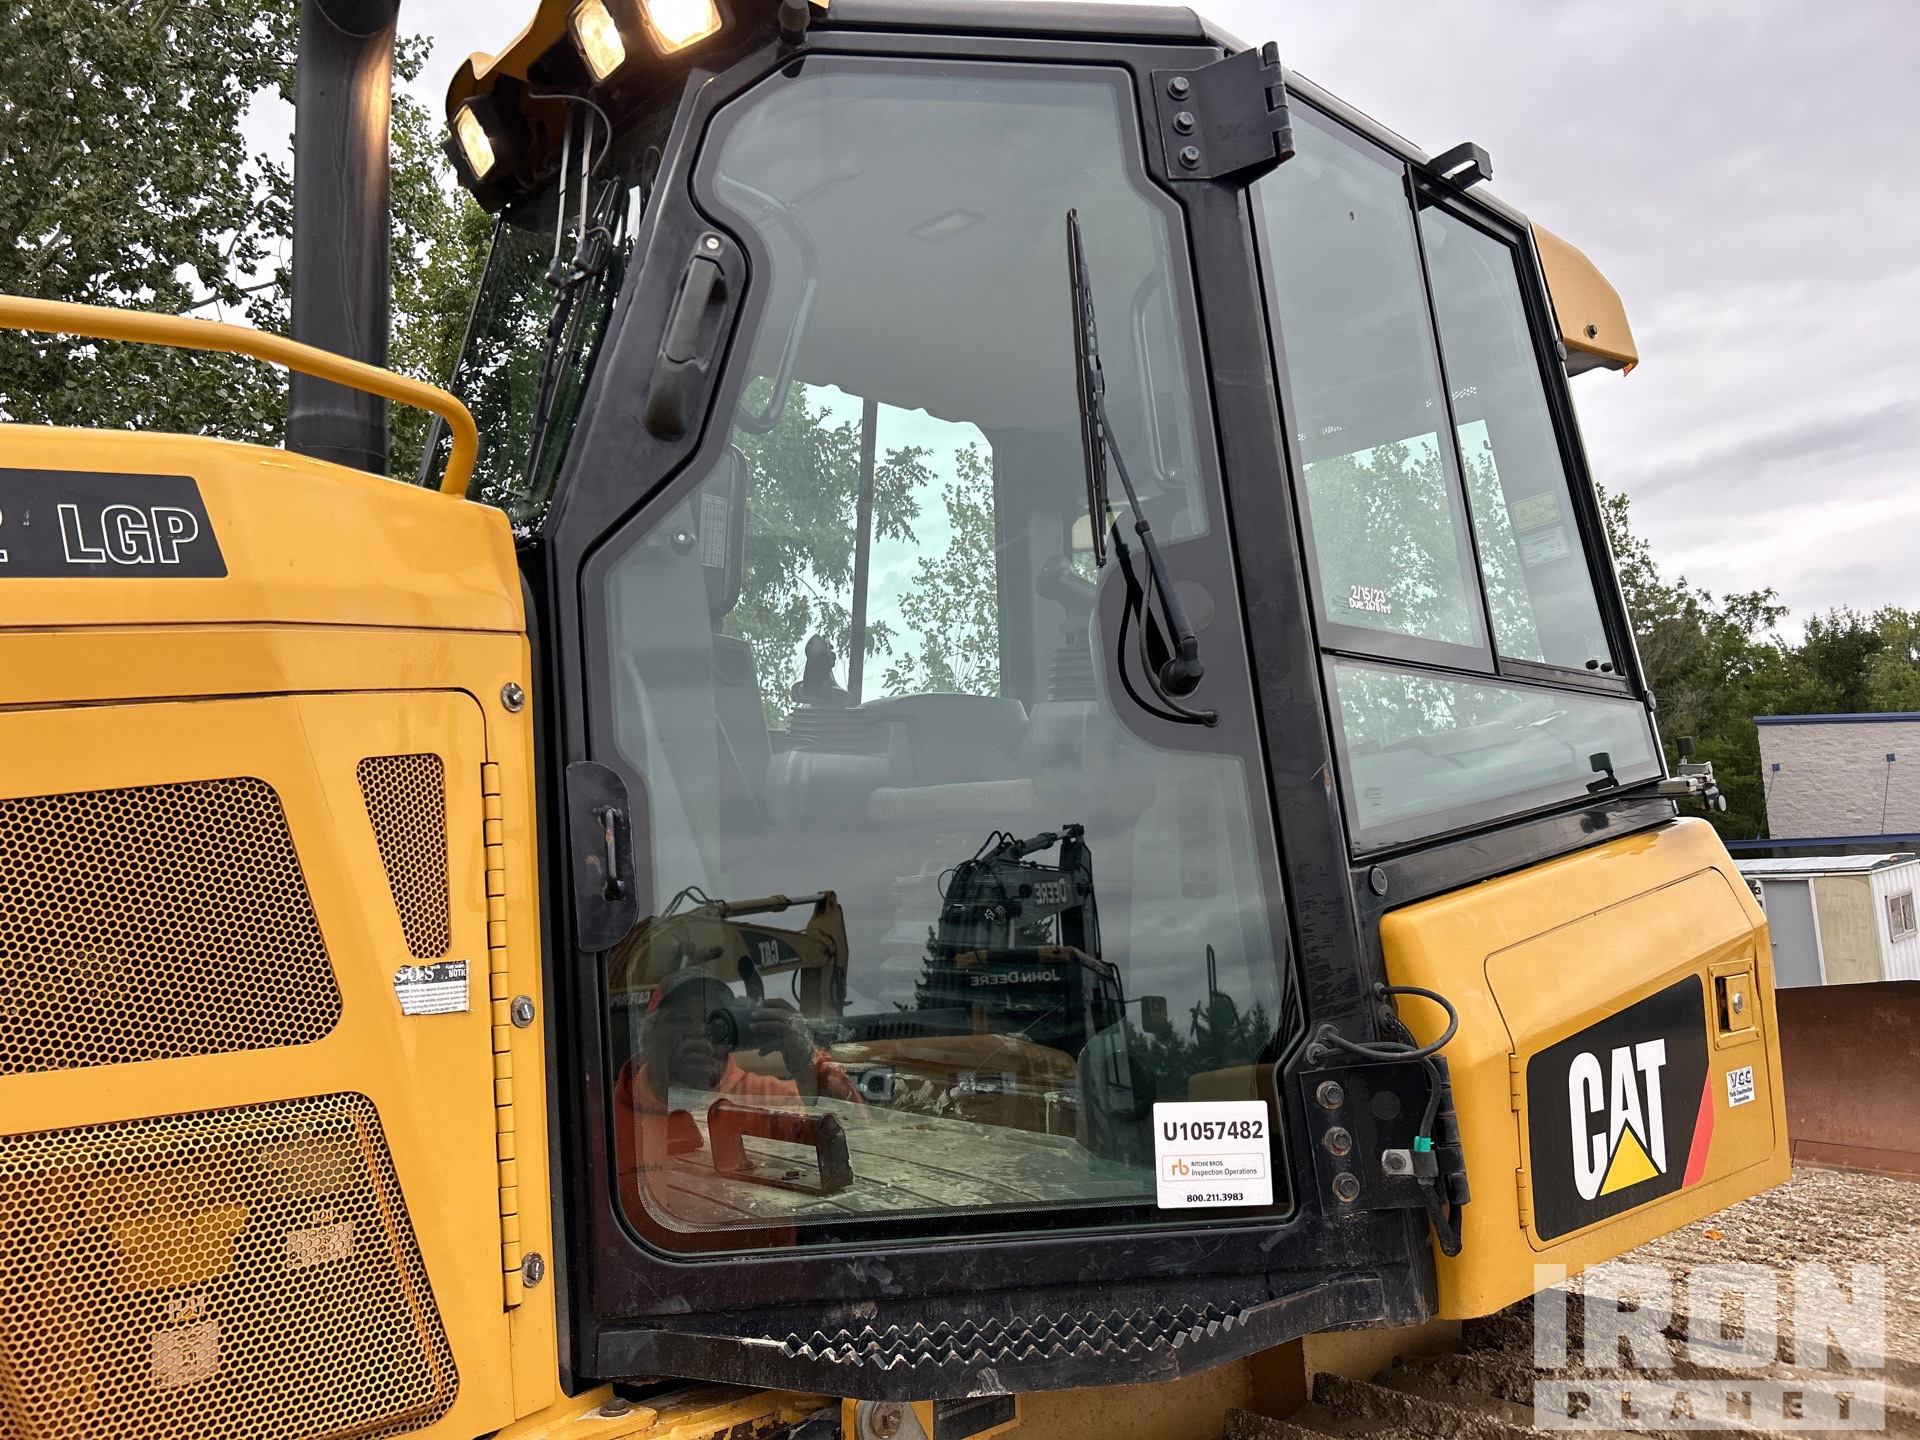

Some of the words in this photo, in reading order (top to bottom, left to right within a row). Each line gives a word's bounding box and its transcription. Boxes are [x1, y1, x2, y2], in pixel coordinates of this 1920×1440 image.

[57, 504, 198, 564] LGP
[1351, 585, 1385, 603] 2/15/23
[1568, 1038, 1667, 1201] CAT
[1163, 1121, 1263, 1141] U1057482
[1192, 1169, 1223, 1177] Inspection
[1225, 1168, 1257, 1176] Operations
[1187, 1193, 1243, 1202] 800.211.3983
